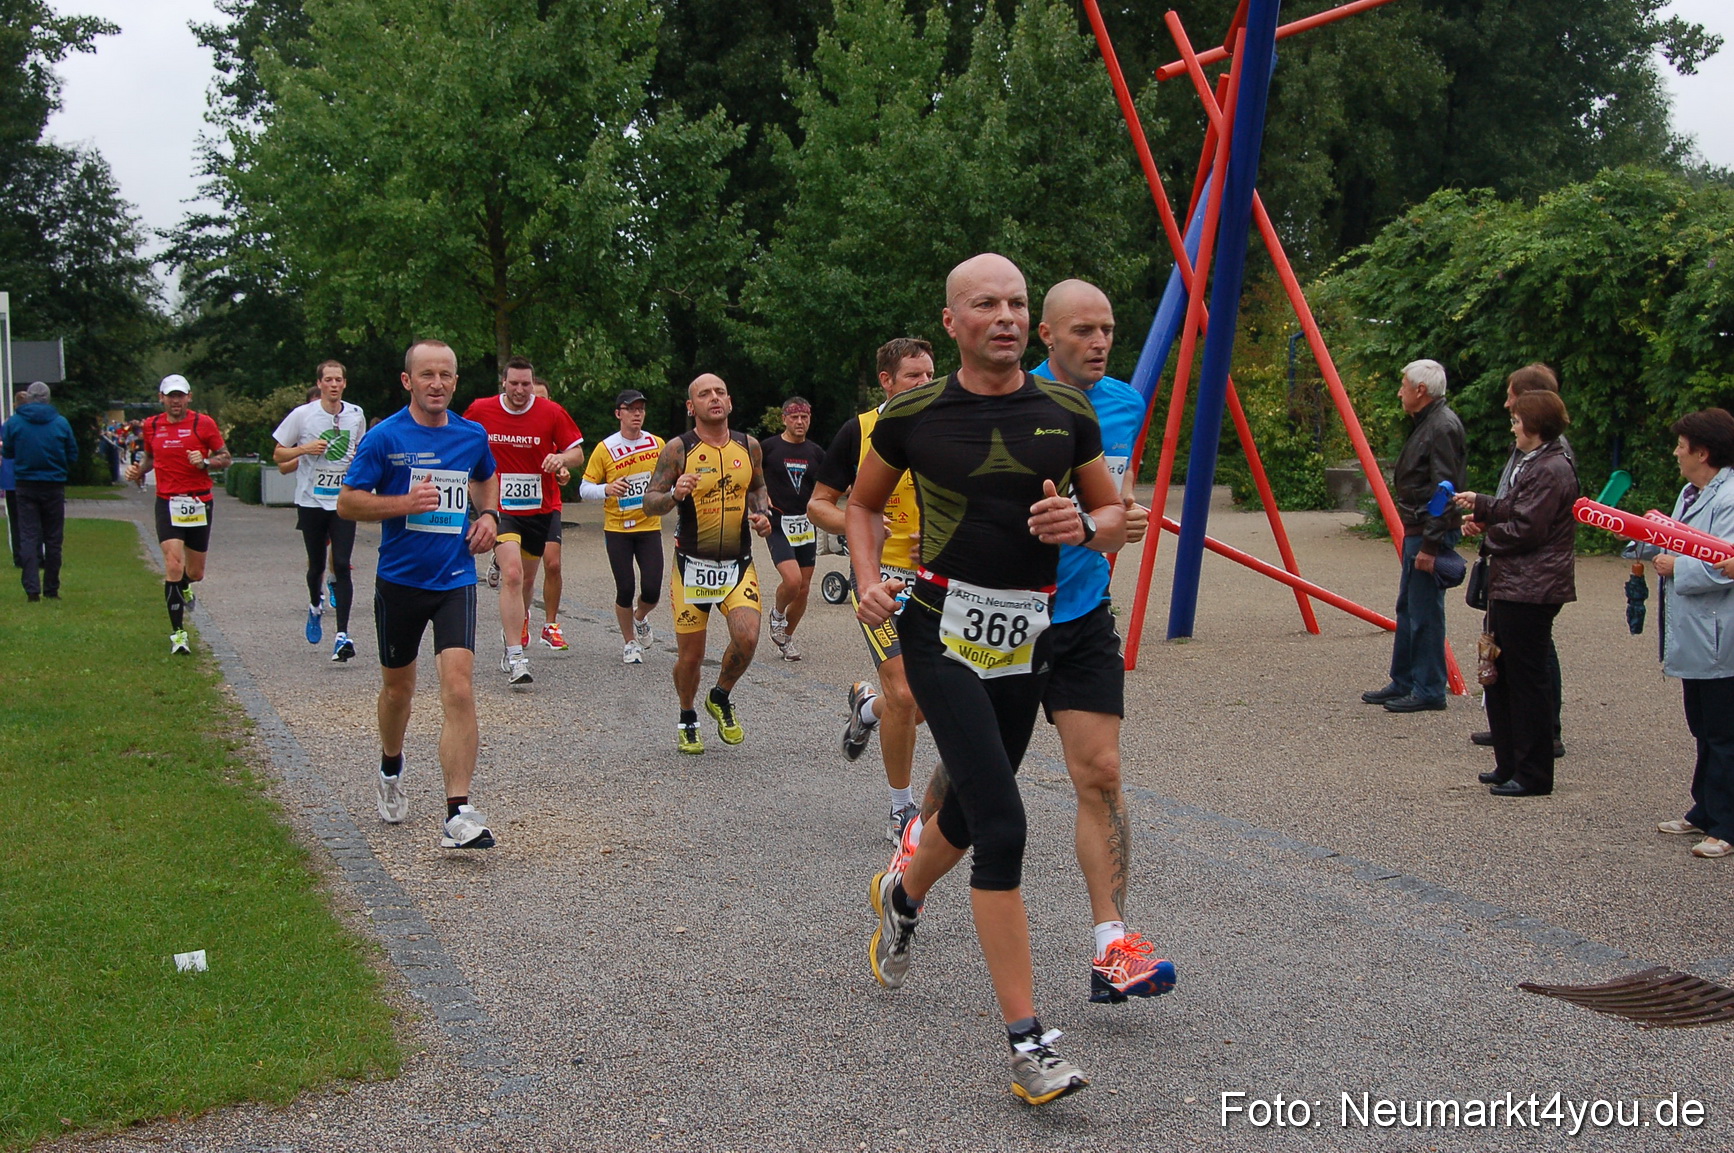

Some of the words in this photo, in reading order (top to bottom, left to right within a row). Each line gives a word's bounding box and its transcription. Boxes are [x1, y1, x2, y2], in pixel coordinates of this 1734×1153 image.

[488, 434, 532, 444] NEUMARKT
[615, 458, 637, 470] MAX
[434, 476, 461, 484] Neumarkt
[505, 483, 537, 498] 2381
[181, 503, 196, 515] 58
[429, 514, 452, 524] Josef
[1643, 527, 1687, 553] BKK
[1690, 543, 1731, 562] udi
[695, 568, 728, 587] 509
[985, 596, 1032, 611] Neumarkt
[963, 608, 1029, 649] 368
